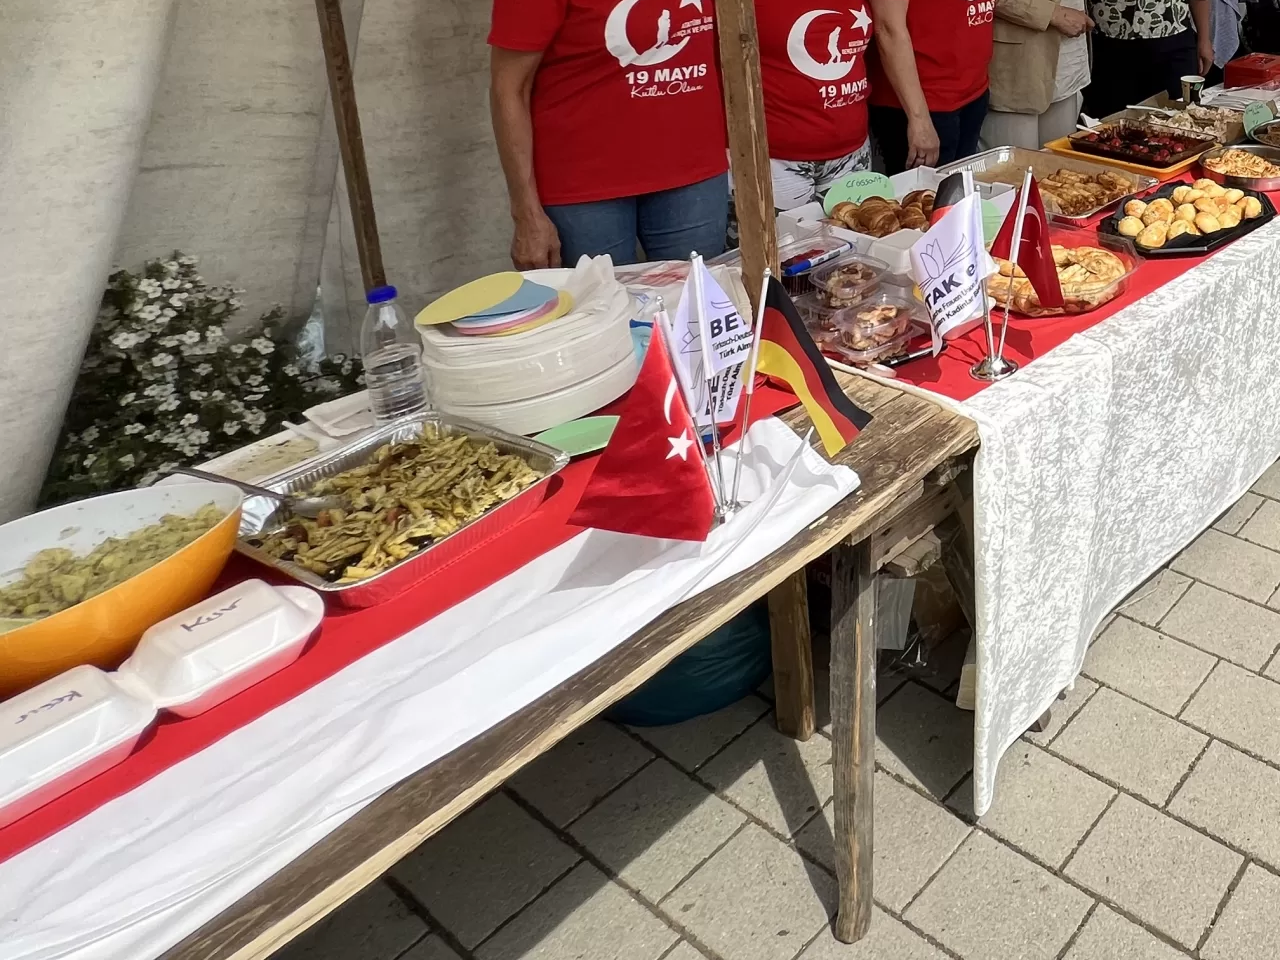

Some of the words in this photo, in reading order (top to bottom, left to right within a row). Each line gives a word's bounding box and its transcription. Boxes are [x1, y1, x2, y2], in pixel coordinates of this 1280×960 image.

[625, 70, 649, 85] 19
[654, 63, 707, 82] MAYIS
[631, 85, 666, 98] Kutlu
[819, 85, 837, 98] 19
[719, 345, 735, 360] Türk
